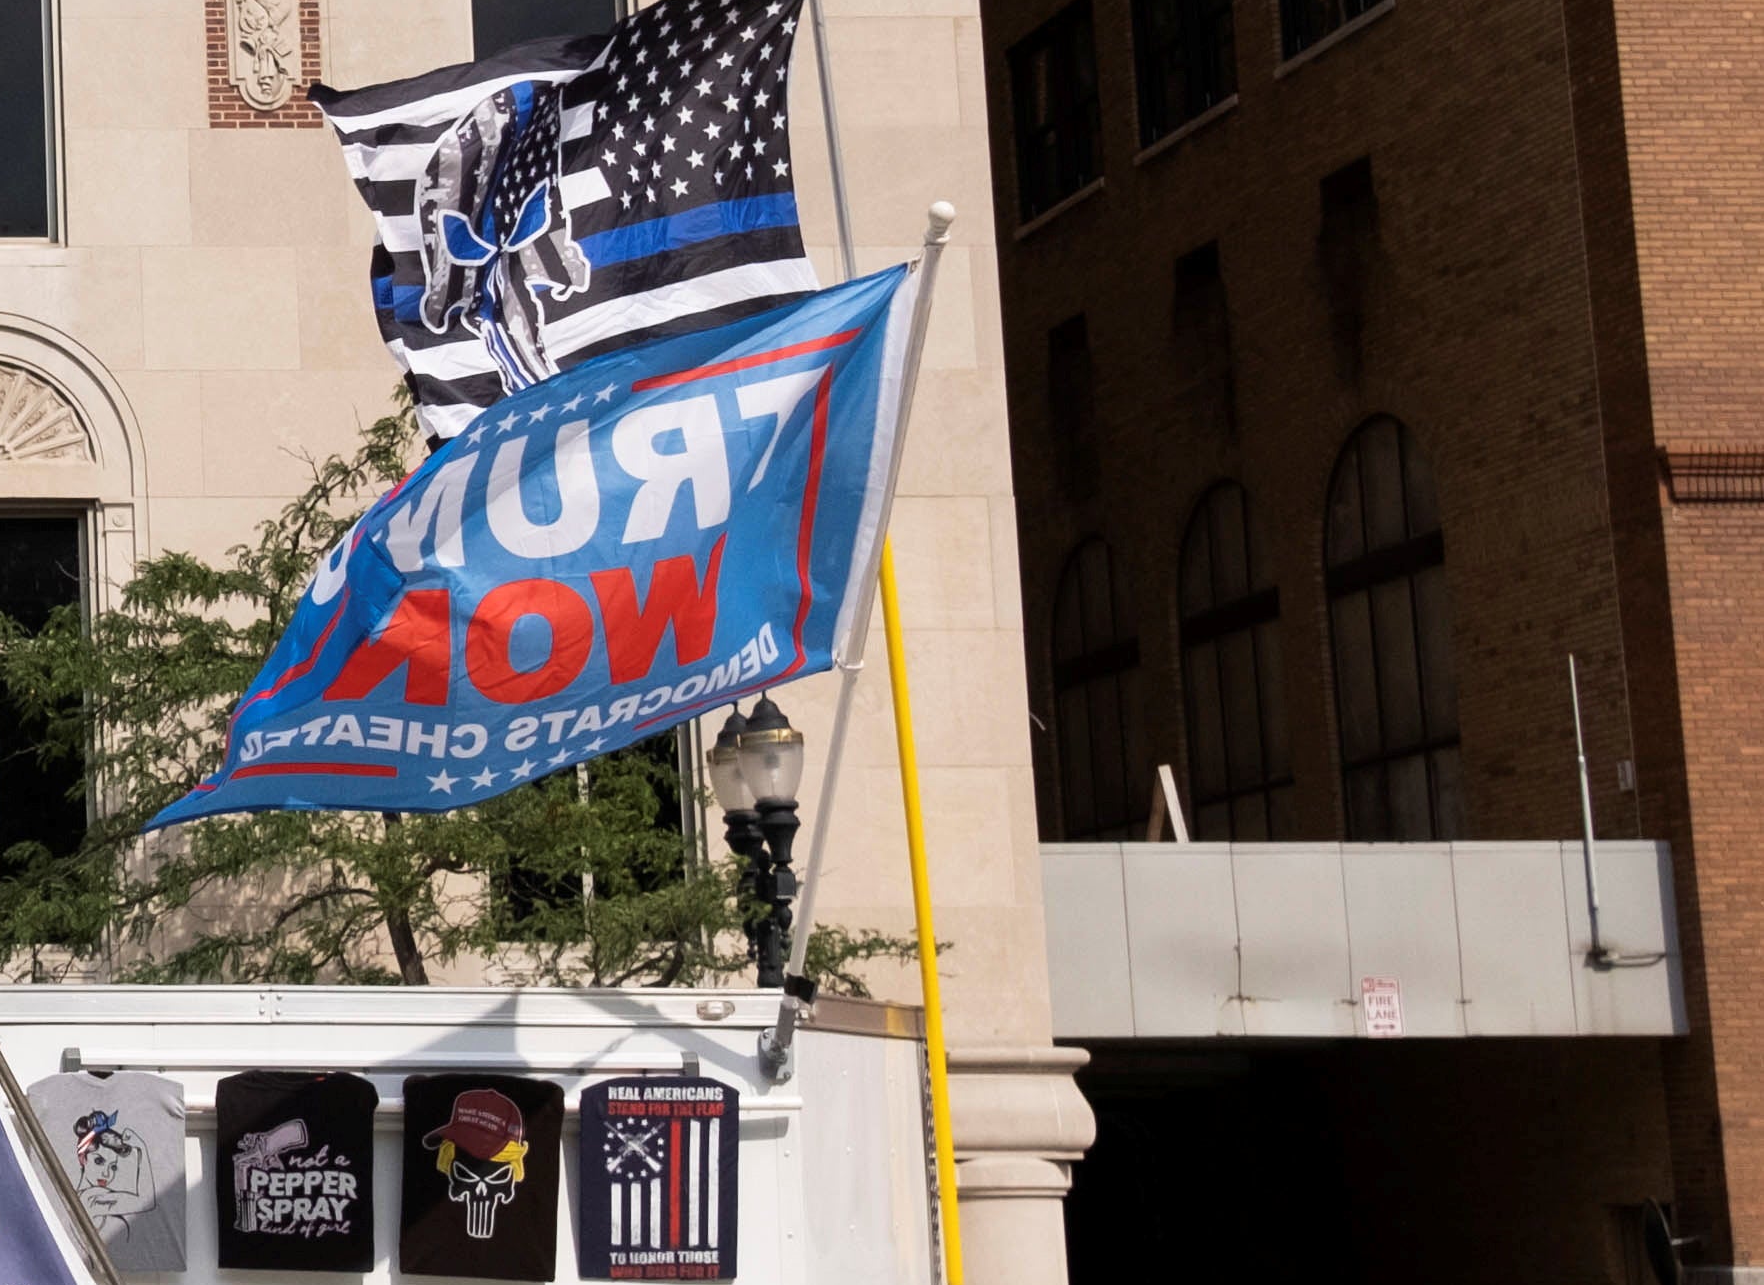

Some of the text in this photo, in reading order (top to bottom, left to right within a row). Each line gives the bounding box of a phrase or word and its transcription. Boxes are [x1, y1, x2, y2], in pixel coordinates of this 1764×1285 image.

[608, 1086, 724, 1100] REAL AMERICANS
[289, 1144, 351, 1168] not a
[250, 1169, 358, 1199] PEPPER
[257, 1196, 350, 1223] SPRAY
[610, 1250, 719, 1265] TO HONOR THOSE
